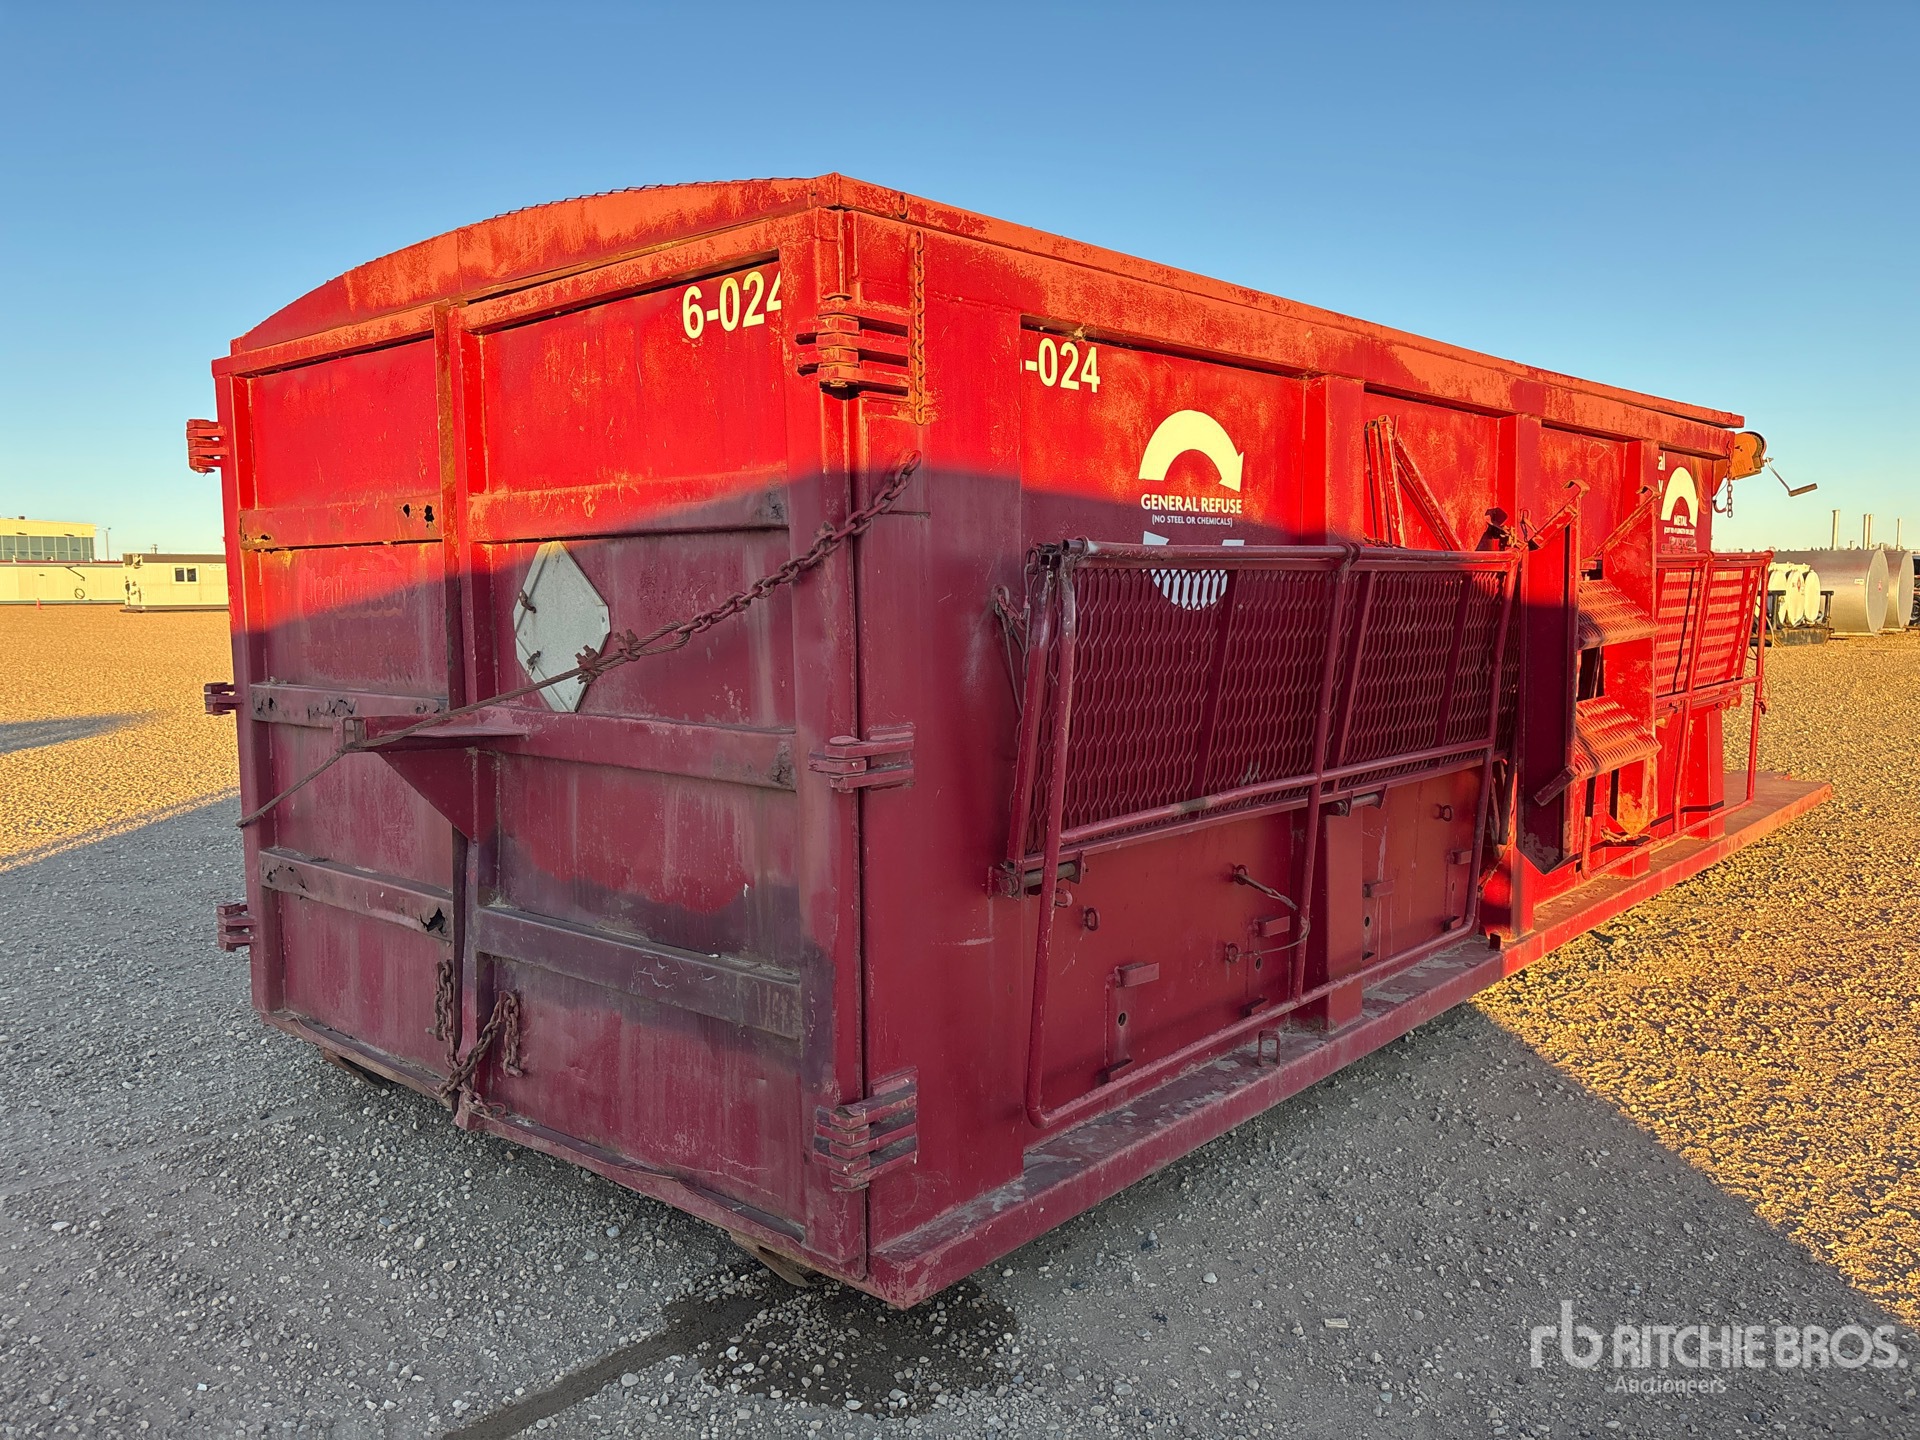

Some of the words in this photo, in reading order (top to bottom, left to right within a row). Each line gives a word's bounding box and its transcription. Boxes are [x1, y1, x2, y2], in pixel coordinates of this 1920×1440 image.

[682, 270, 782, 339] 6-024
[1141, 494, 1199, 512] GENERAL
[1201, 498, 1242, 514] REFUSE
[1152, 514, 1165, 525] (NO
[1167, 515, 1185, 524] STEEL
[1185, 516, 1196, 525] OR
